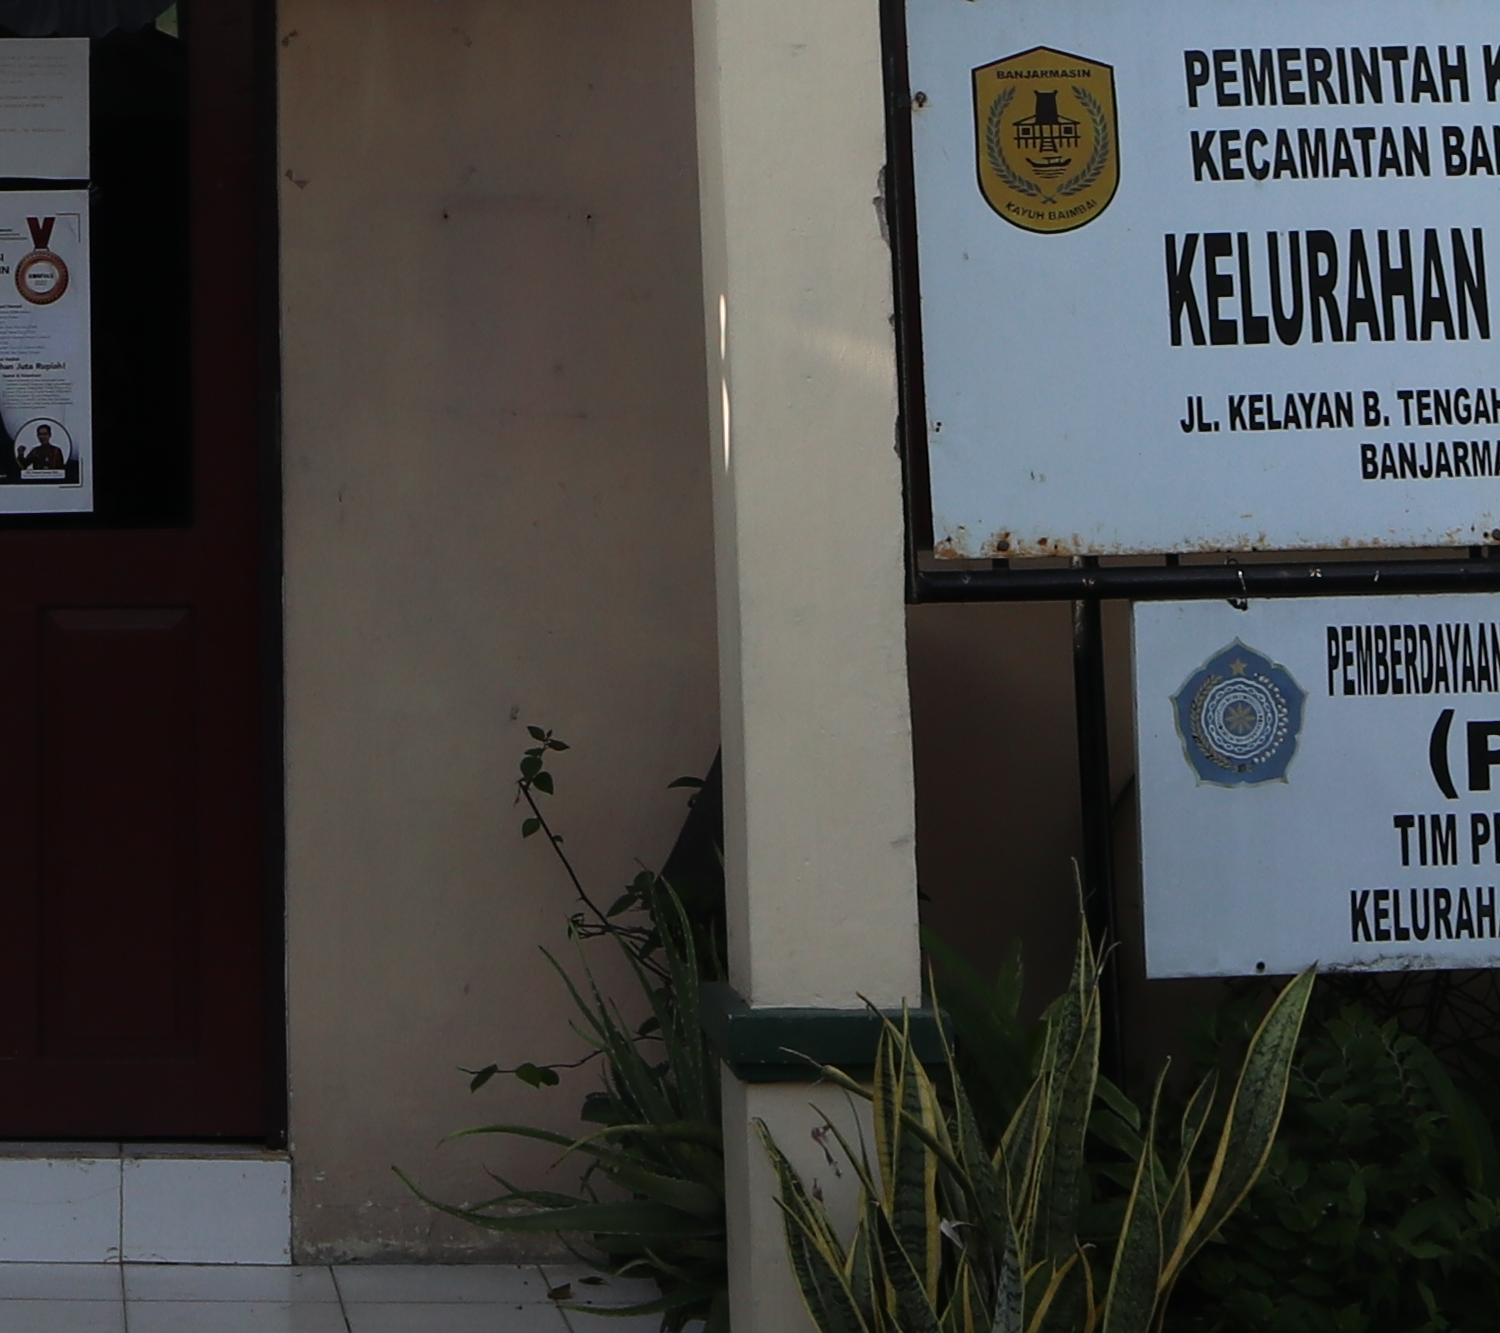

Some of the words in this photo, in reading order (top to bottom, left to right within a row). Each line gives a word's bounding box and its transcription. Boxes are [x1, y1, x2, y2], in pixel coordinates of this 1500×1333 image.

[996, 69, 1091, 80] BANJARMASIN
[1183, 45, 1471, 107] PEMERINTAH
[1190, 125, 1431, 182] KECAMATAN
[1005, 201, 1045, 220] KAYUH
[1049, 199, 1097, 221] BAIMBAI
[1163, 227, 1490, 348] KELURAHAN
[1180, 396, 1220, 434] JL.
[1228, 391, 1359, 432] KELAYAN
[1364, 389, 1390, 428] B.
[1393, 813, 1459, 867] TIM
